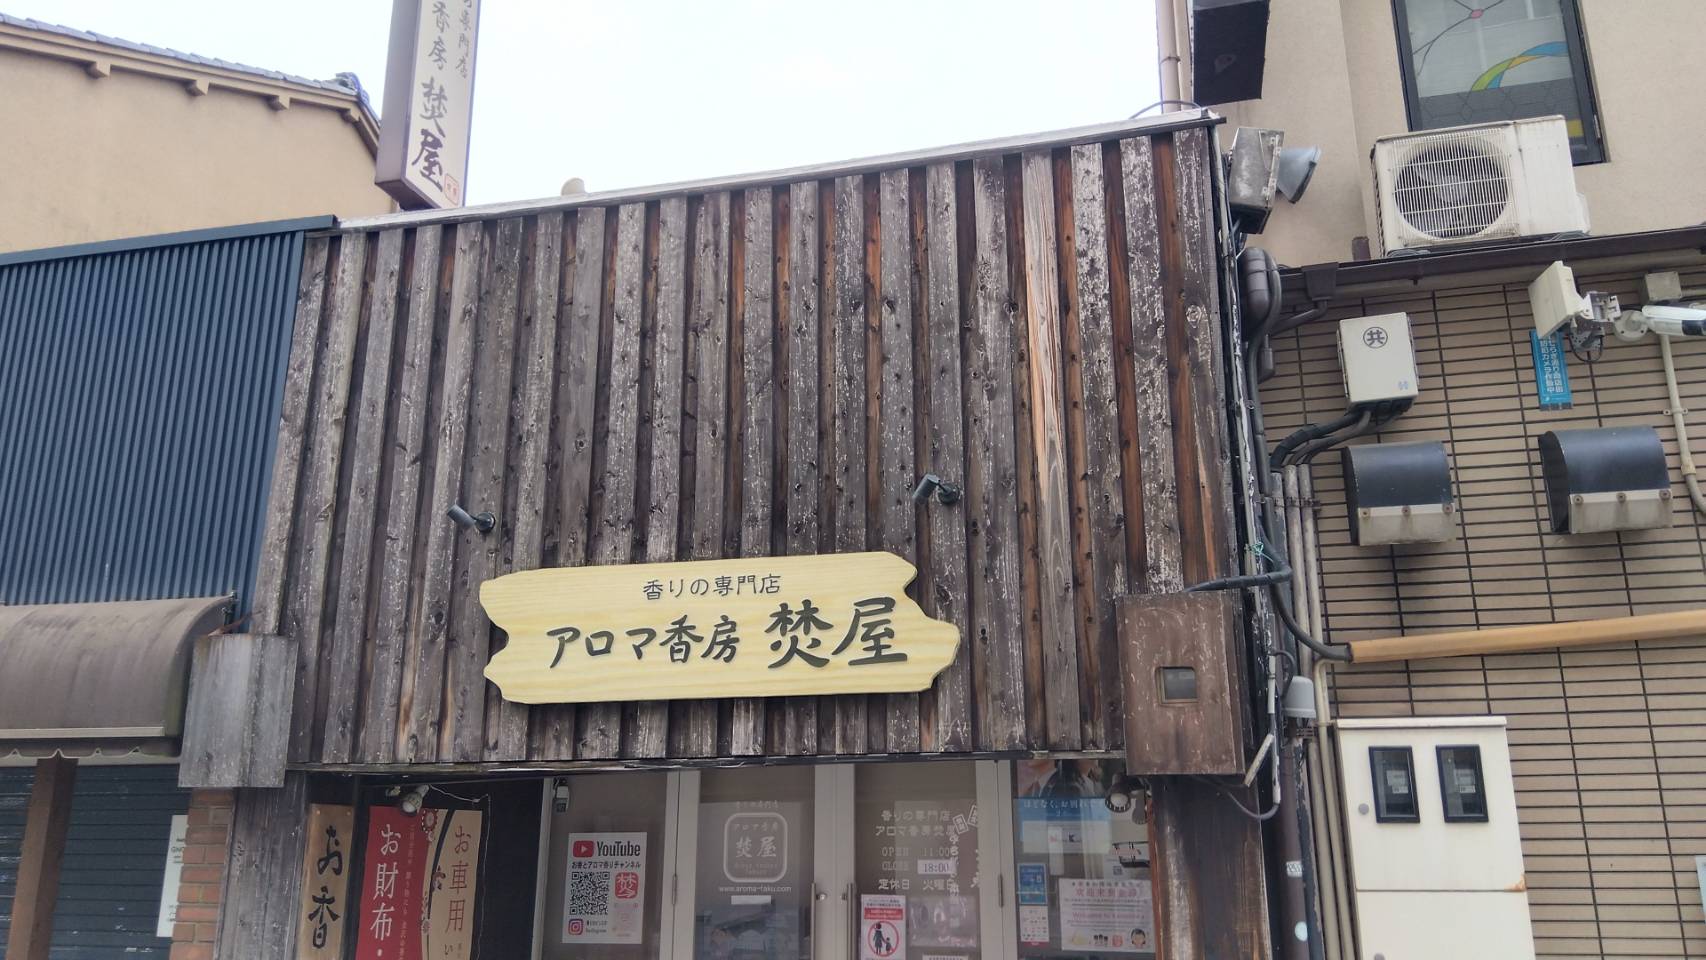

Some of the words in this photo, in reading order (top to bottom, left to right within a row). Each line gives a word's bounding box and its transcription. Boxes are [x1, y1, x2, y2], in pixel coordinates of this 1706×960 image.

[1366, 328, 1386, 347] 共
[643, 573, 782, 601] 香りの専門店
[546, 614, 741, 669] アロマ香房
[764, 596, 908, 669] 焚屋
[597, 841, 641, 857] YouTube
[736, 836, 777, 857] 焚屋
[924, 862, 950, 873] 18:00
[308, 825, 343, 949] お香
[446, 825, 472, 932] お車用
[878, 879, 910, 890] 定休日
[922, 879, 955, 890] 火曜日
